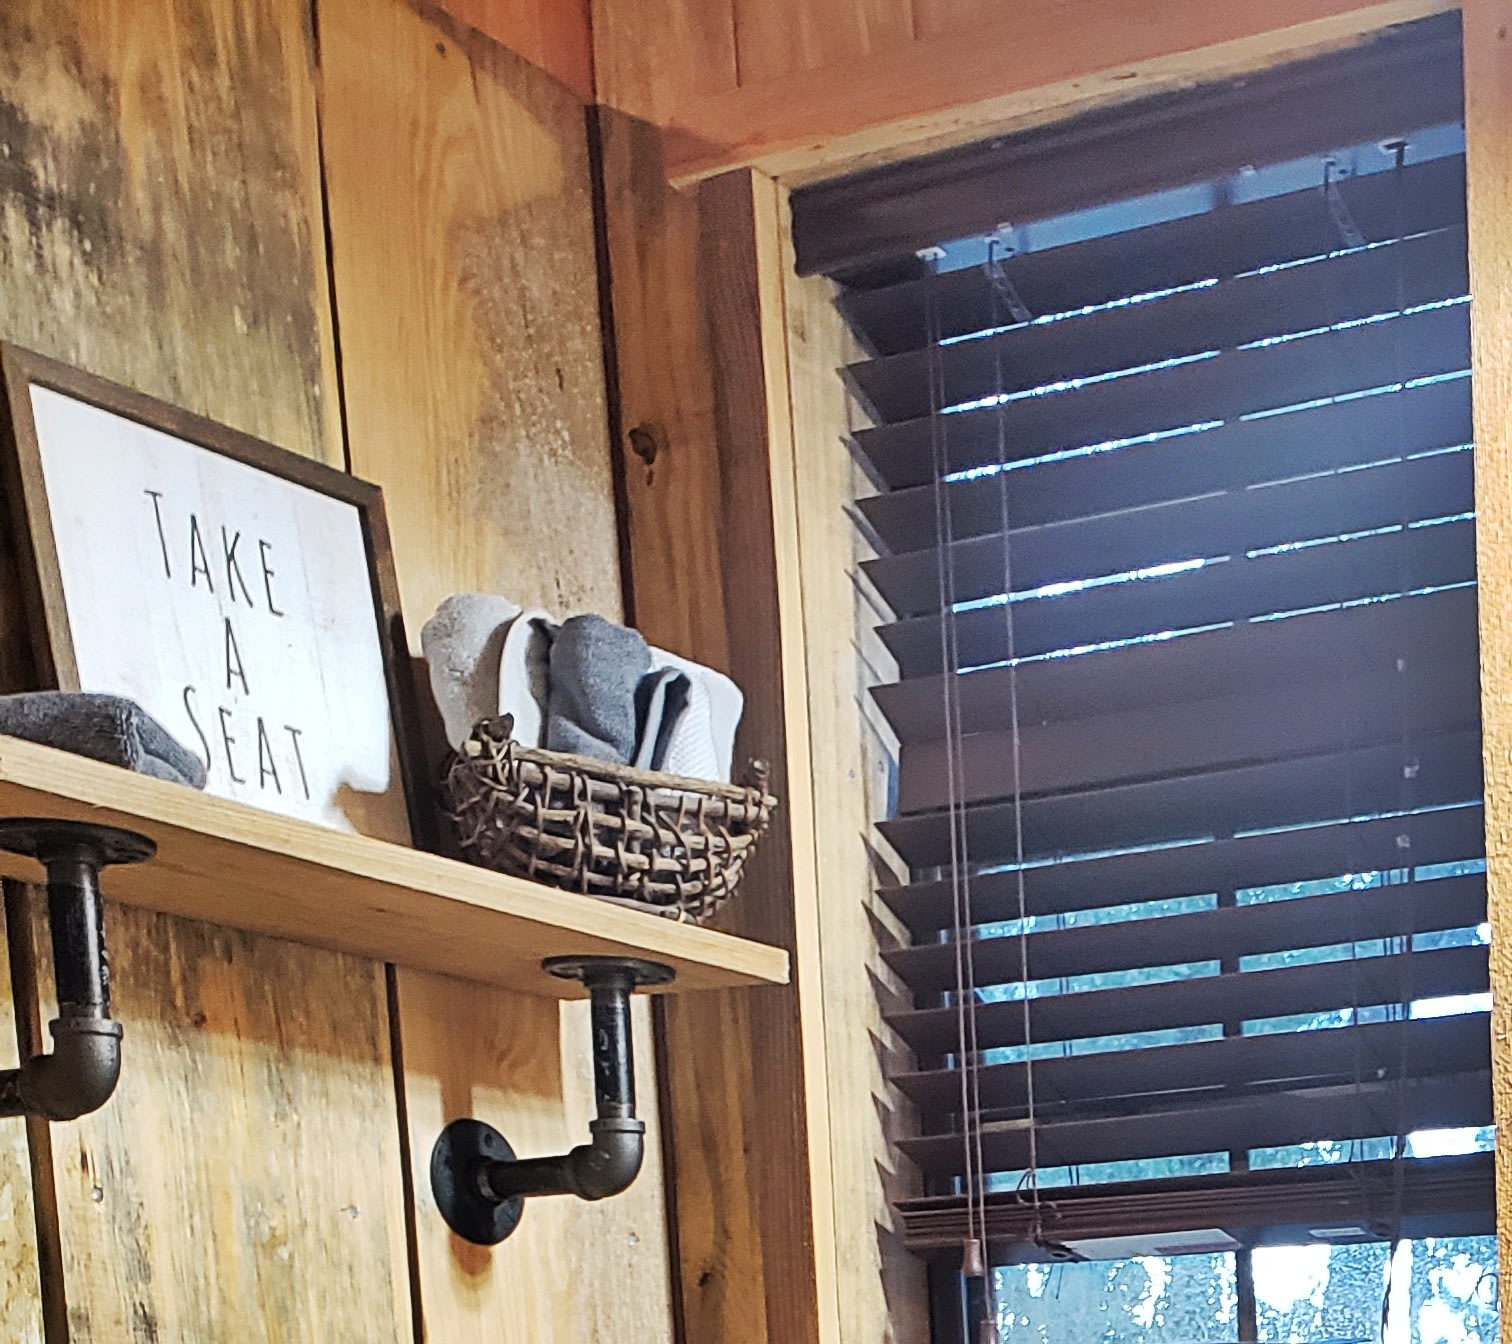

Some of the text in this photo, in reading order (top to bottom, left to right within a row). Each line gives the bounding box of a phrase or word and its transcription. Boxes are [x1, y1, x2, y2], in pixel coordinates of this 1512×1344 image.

[144, 490, 284, 616] TAKE
[224, 617, 249, 696] A
[183, 685, 310, 801] SEAT
